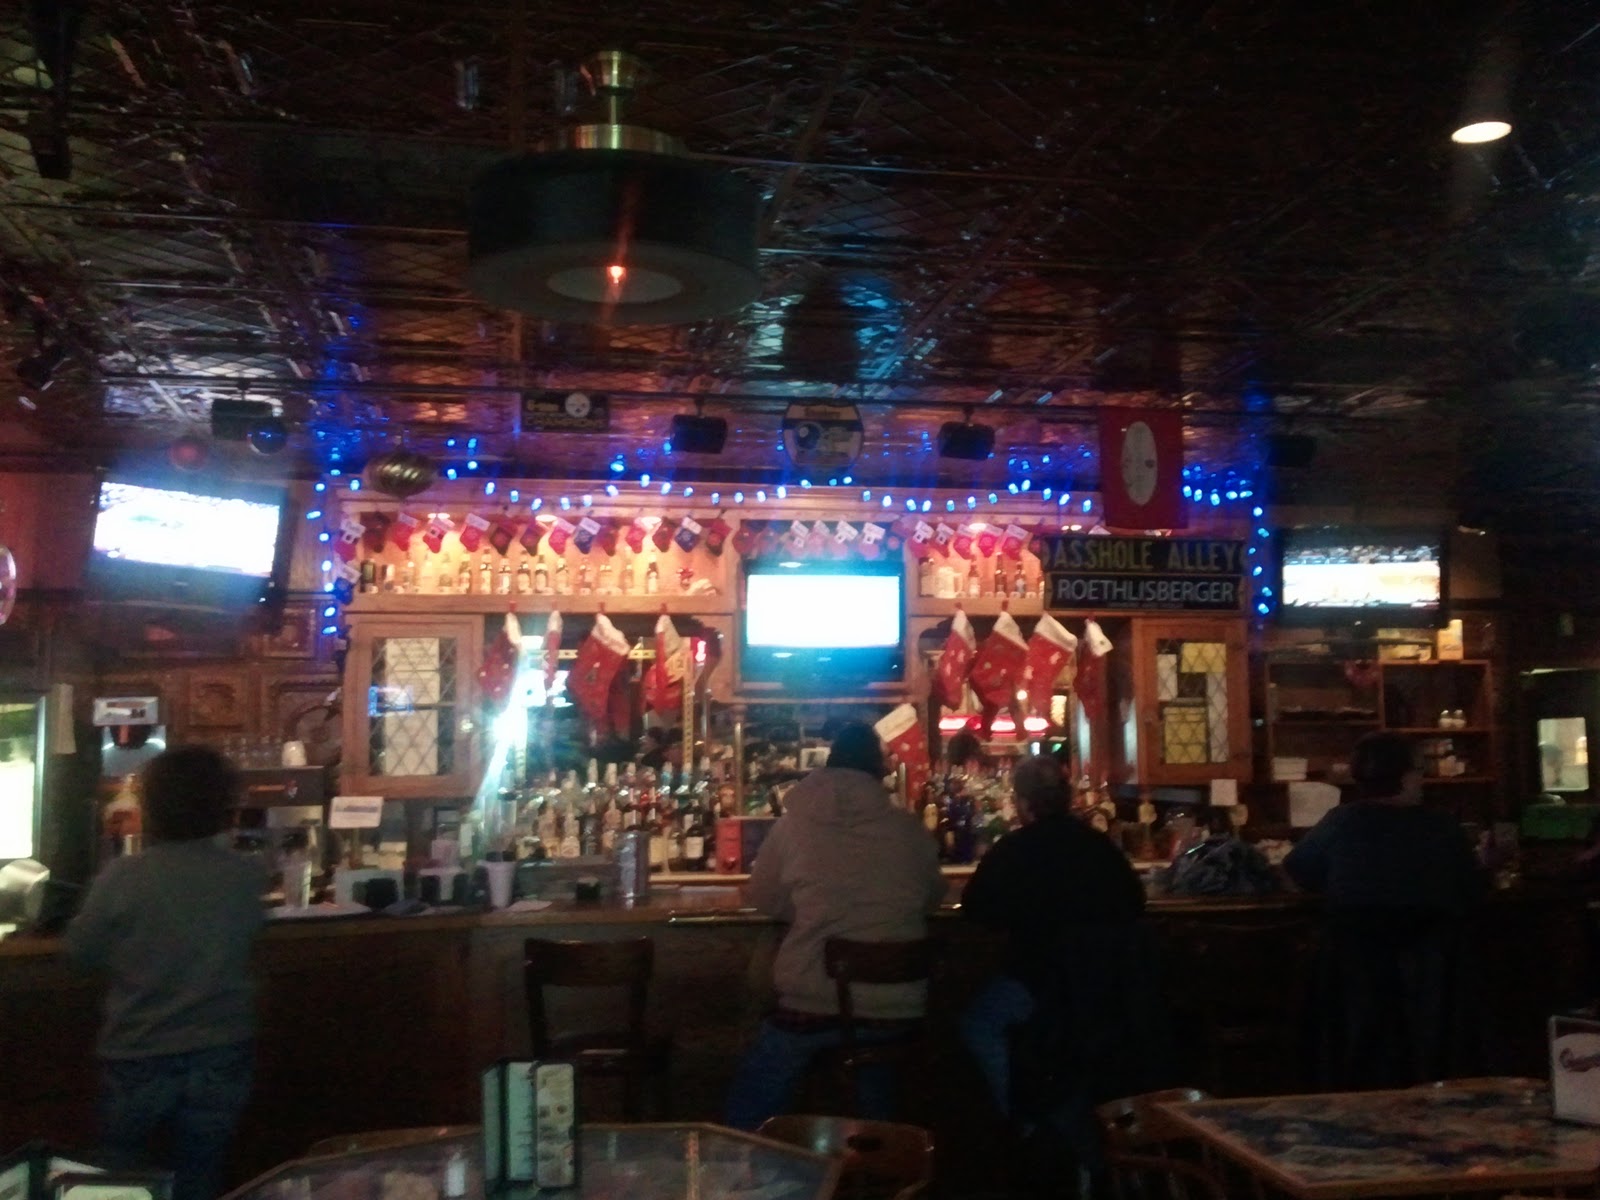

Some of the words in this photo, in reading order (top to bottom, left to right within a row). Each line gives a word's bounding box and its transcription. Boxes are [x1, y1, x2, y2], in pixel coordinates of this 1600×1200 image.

[1054, 539, 1154, 569] ASSHOLE
[1167, 541, 1236, 571] ALLEY
[1057, 579, 1234, 602] ROETHLISBERGER
